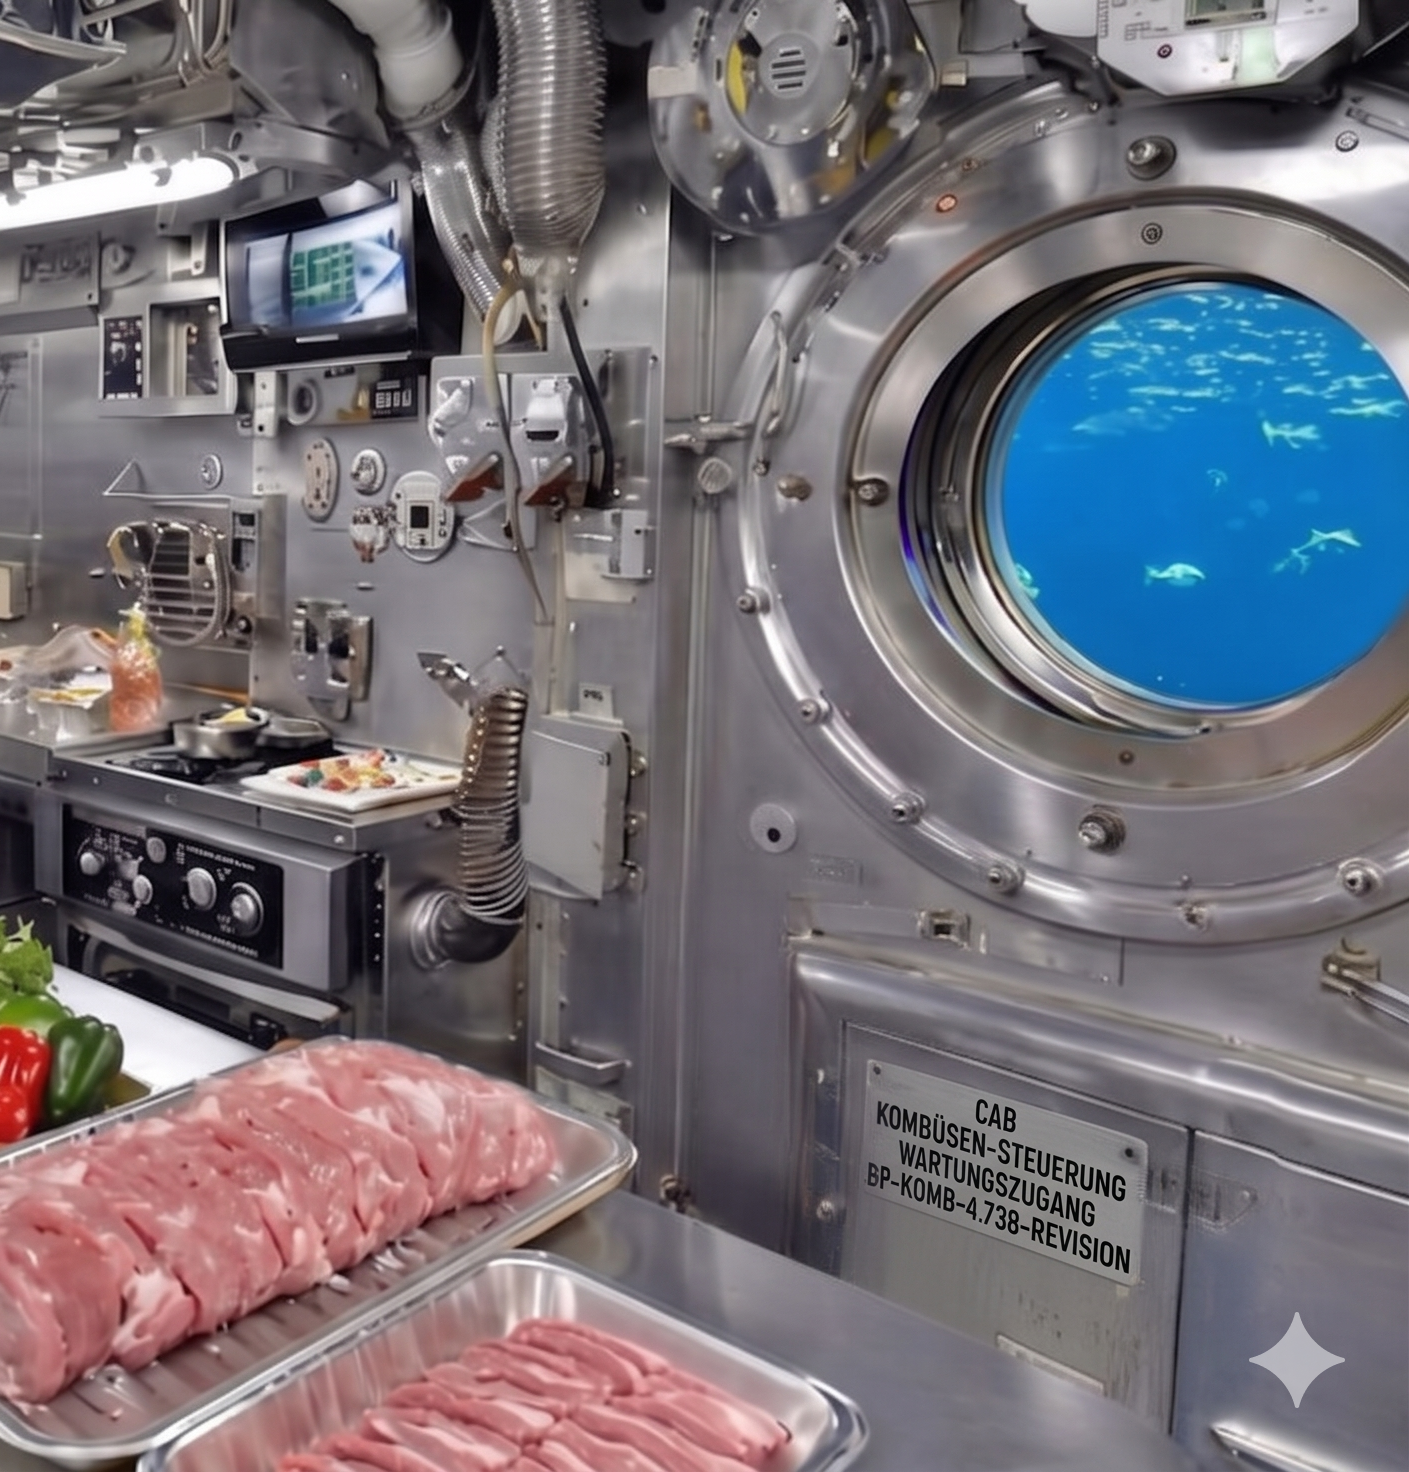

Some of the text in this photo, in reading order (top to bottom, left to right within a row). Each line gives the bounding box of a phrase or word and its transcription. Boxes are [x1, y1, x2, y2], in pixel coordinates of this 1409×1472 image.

[876, 1101, 1127, 1202] KOMBÜSEN-STEUERUNG
[975, 1099, 1017, 1133] CAB
[867, 1162, 1131, 1274] BP-KOMB-4.738-REVISION
[899, 1140, 1096, 1227] WARTUNGSZUGANG
